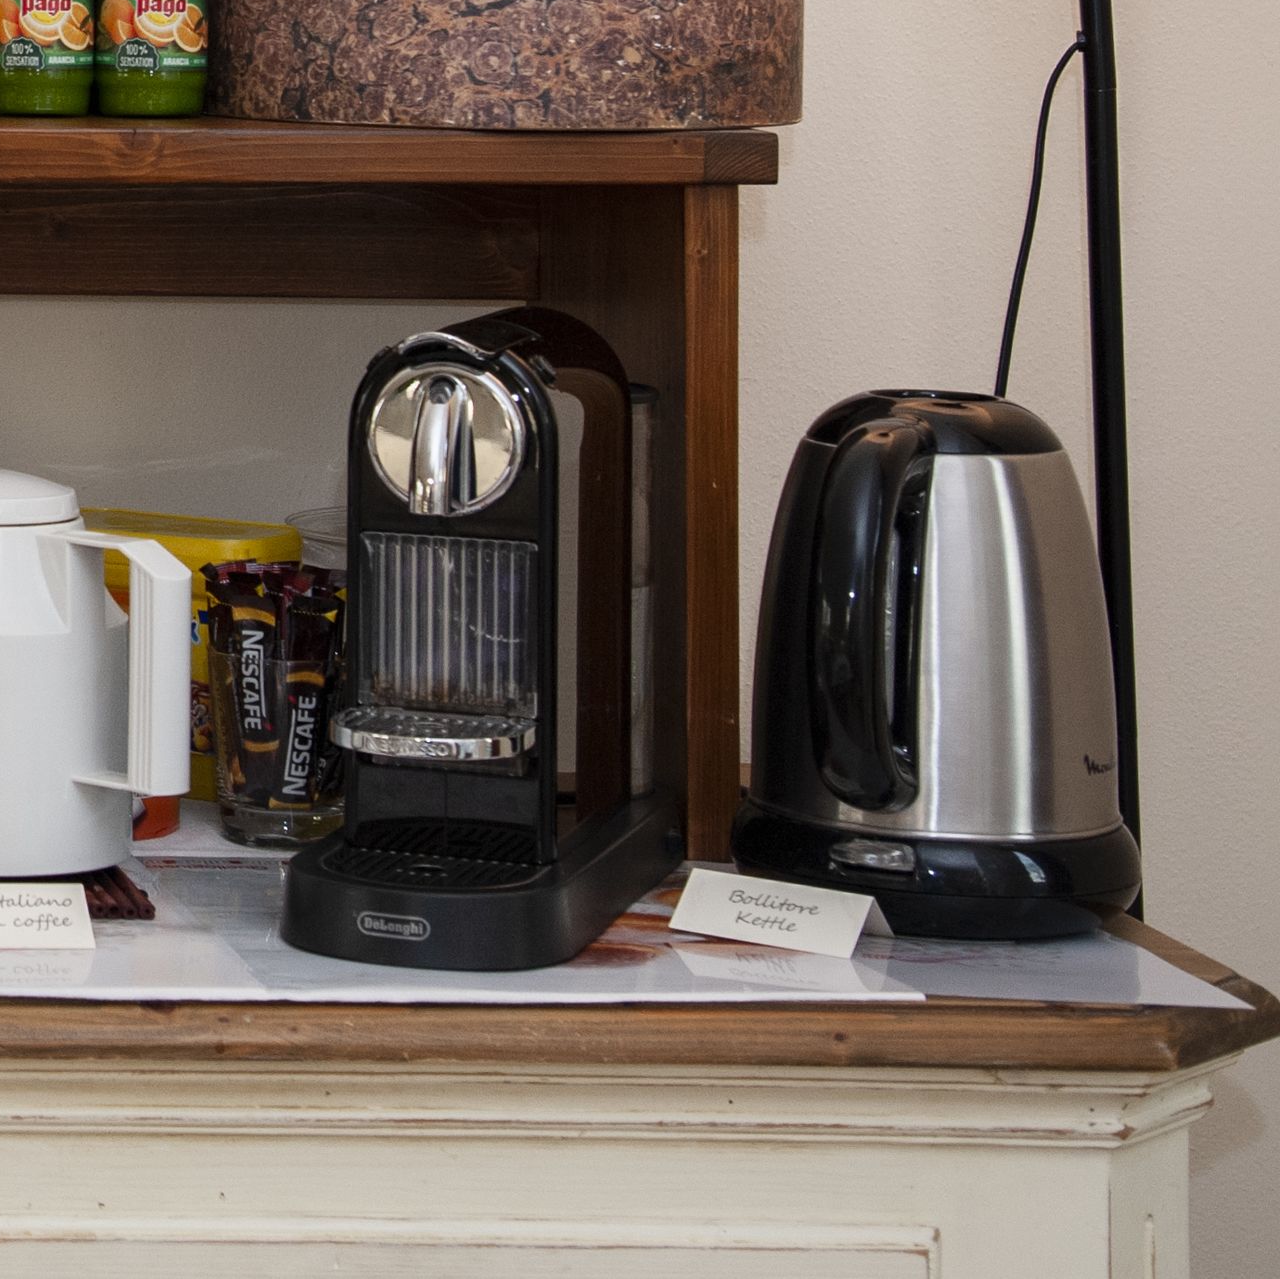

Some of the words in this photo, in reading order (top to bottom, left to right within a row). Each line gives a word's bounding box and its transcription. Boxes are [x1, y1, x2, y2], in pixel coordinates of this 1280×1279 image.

[728, 889, 821, 916] Bollitore
[13, 914, 74, 931] coffee
[735, 910, 799, 933] Kettle
